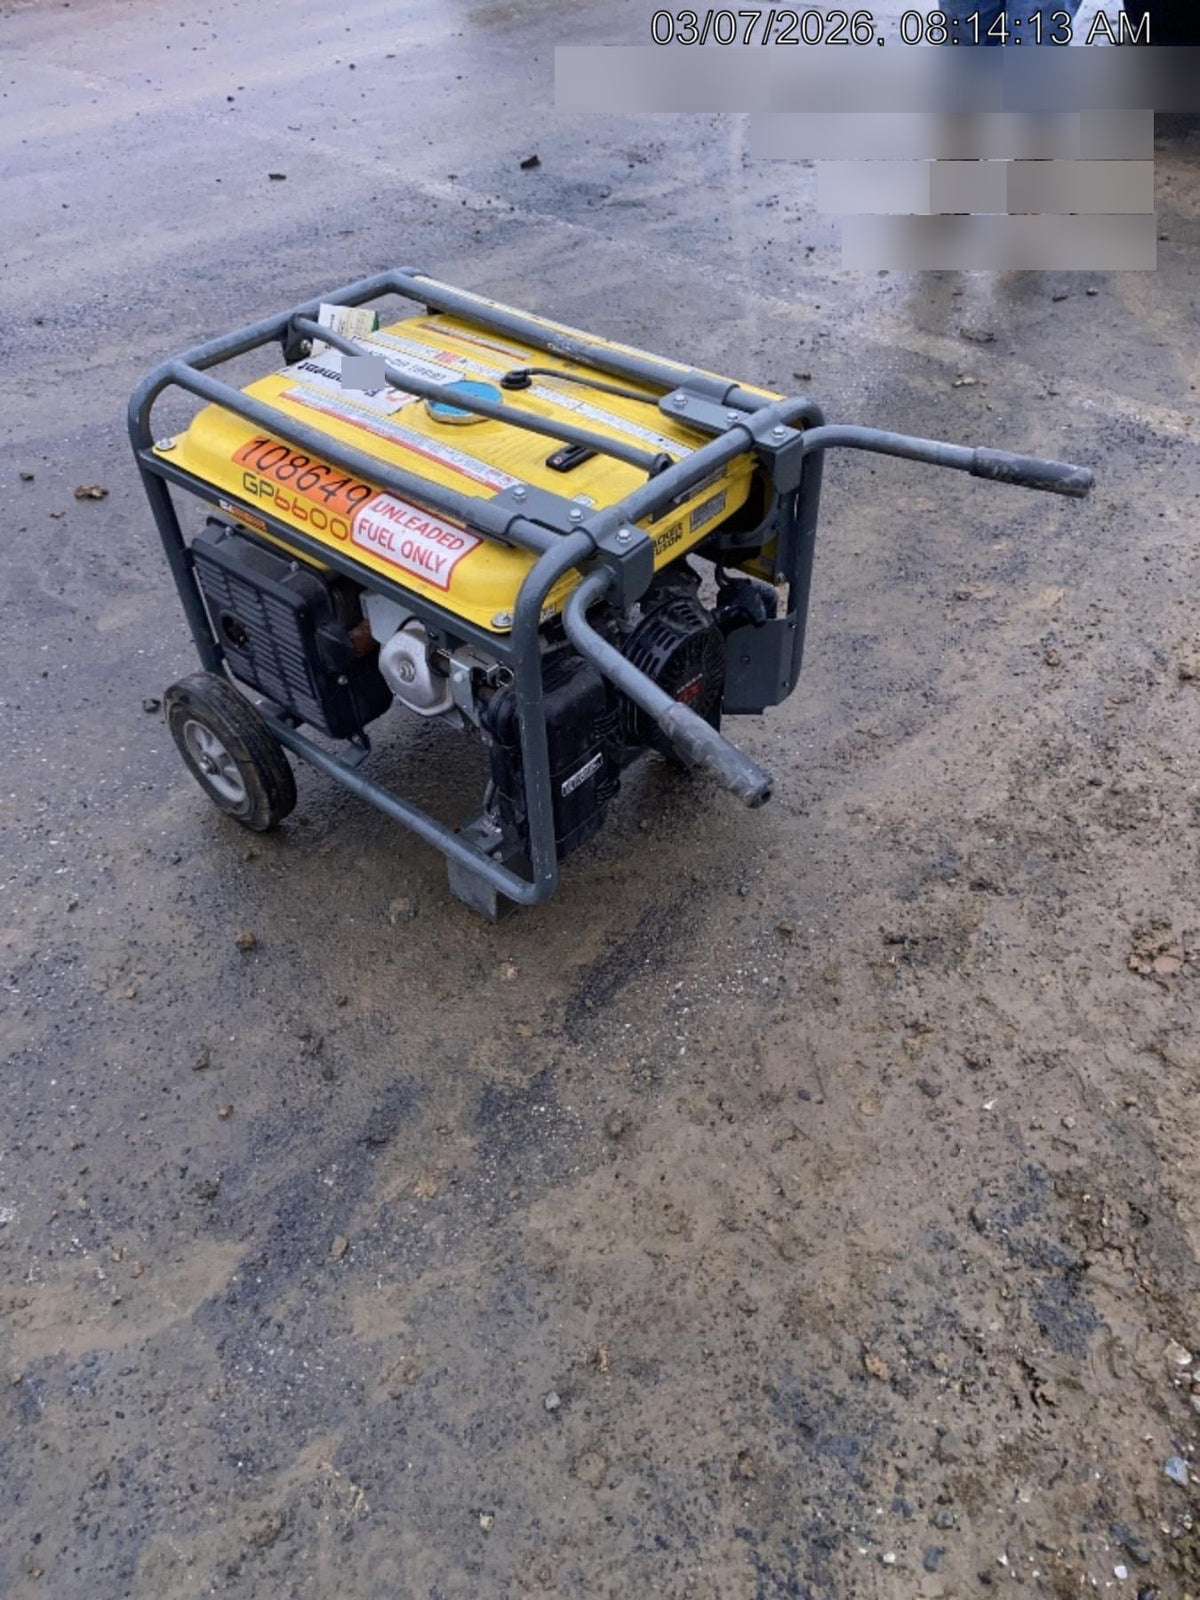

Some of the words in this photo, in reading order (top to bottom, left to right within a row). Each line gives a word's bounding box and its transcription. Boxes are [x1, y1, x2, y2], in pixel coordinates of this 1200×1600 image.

[241, 438, 372, 514] 108649
[242, 472, 349, 542] GP6600
[357, 518, 401, 552] FUEL
[400, 539, 448, 575] ONLY
[371, 500, 466, 551] UNLEADED
